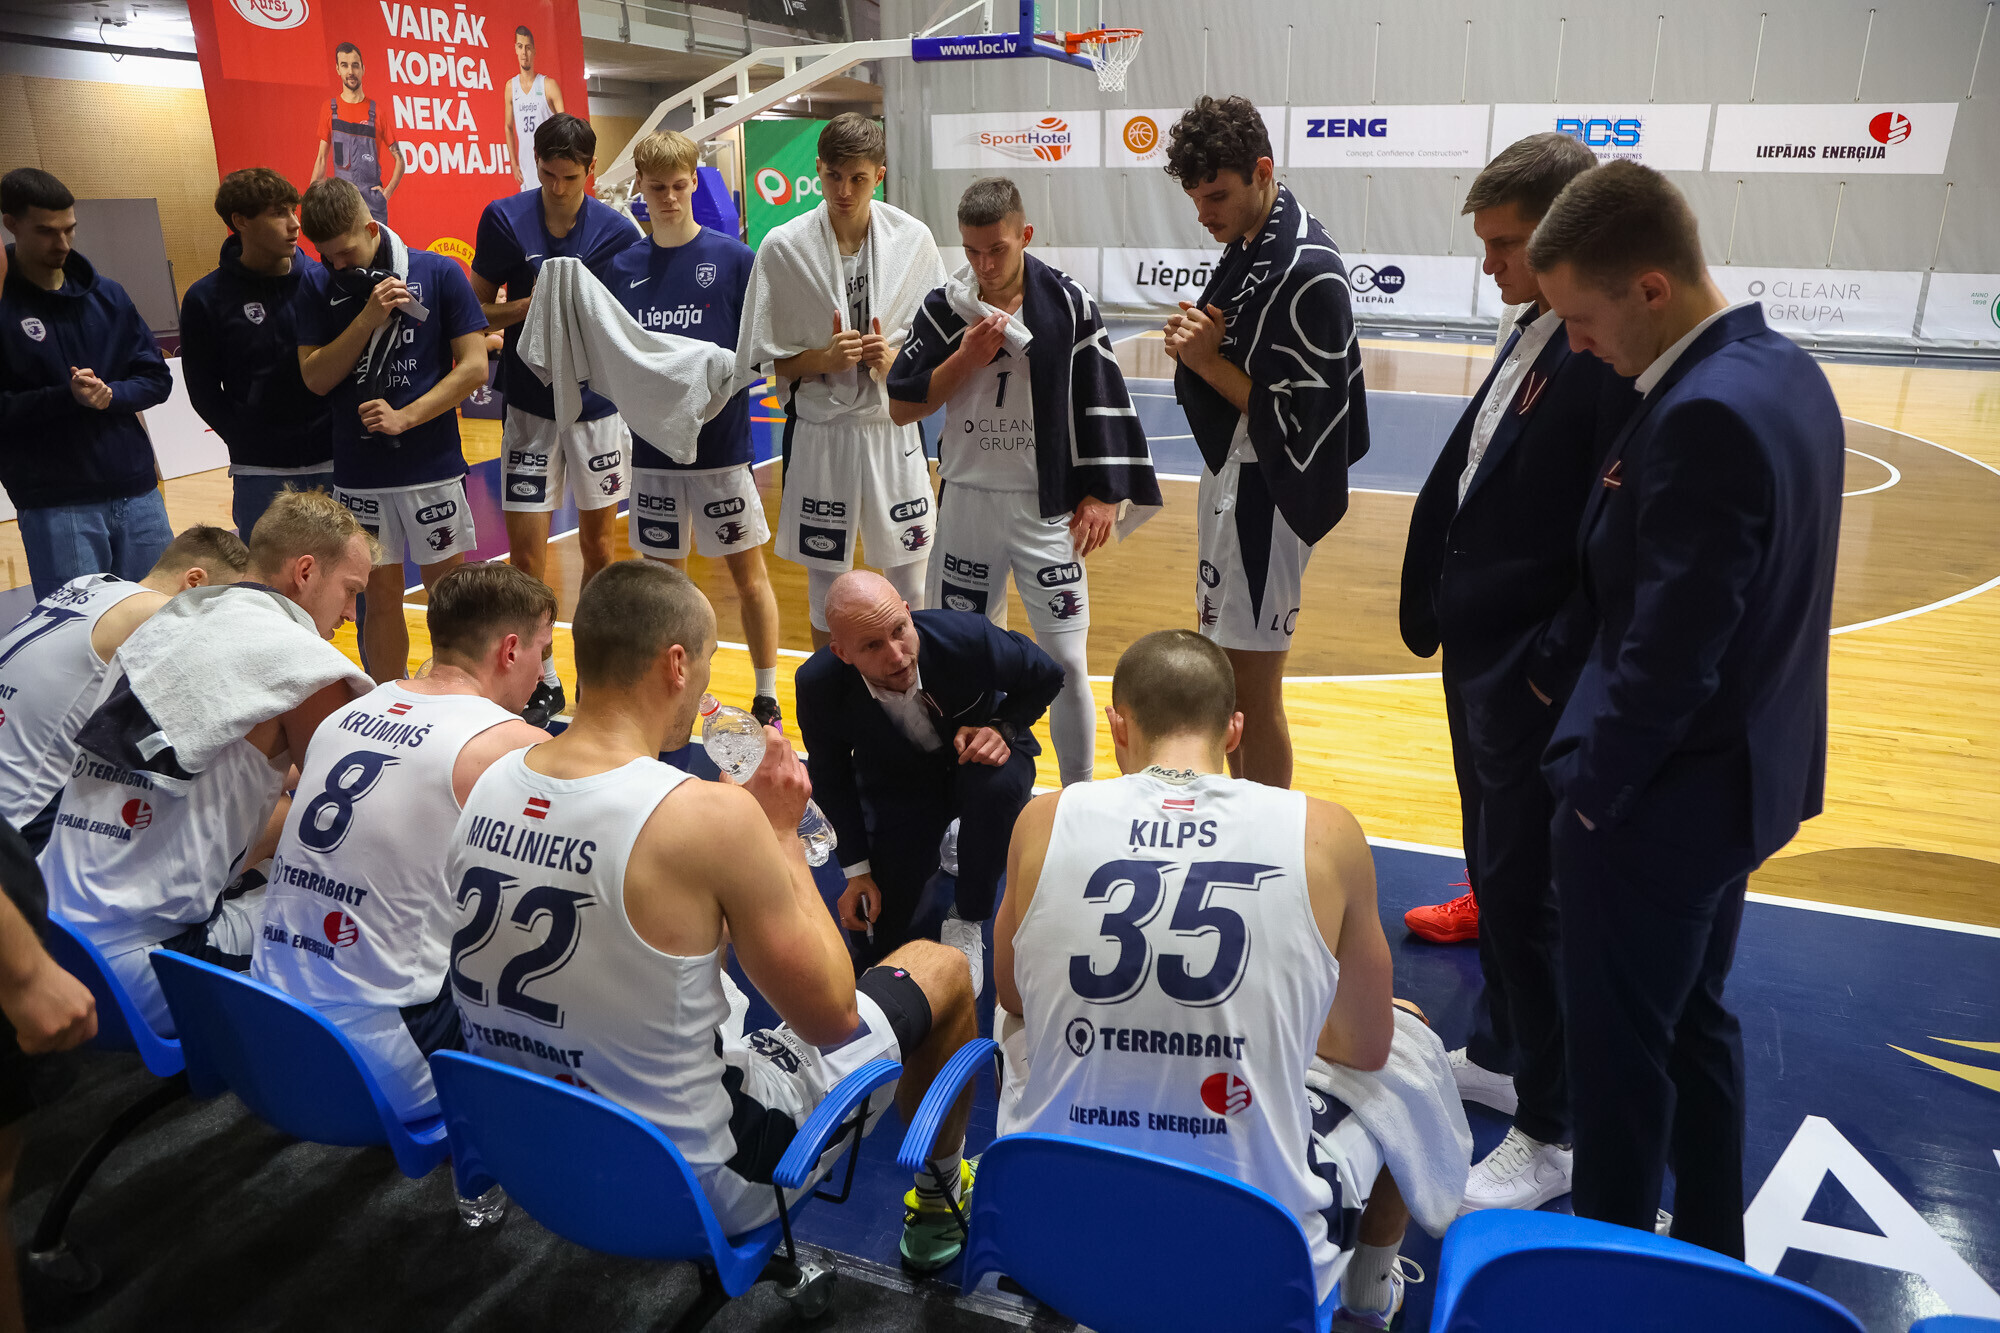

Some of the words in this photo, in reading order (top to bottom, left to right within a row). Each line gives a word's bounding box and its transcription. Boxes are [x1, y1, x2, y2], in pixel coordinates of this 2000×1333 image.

[379, 0, 489, 48] VAIRĀK
[939, 39, 1017, 56] www.loc.lv
[387, 46, 494, 91] KOPĪGA
[392, 91, 478, 132] NEKĀ
[523, 116, 536, 133] 35
[980, 132, 1071, 147] SportHotel
[1306, 119, 1388, 138] ZENG
[1556, 119, 1642, 147] BCS
[398, 134, 512, 175] DOMĀJI!
[1756, 143, 1817, 159] LIEPĀJAS
[1822, 145, 1886, 162] ENERĢIJA
[1379, 275, 1402, 285] LSEZ
[1772, 280, 1861, 300] CLEANR
[1356, 295, 1395, 304] LIEPĀJA
[1768, 304, 1844, 323] GRUPA
[638, 303, 703, 330] Liepāja
[994, 370, 1013, 409] 1
[979, 437, 1037, 451] GRUPA
[509, 450, 548, 468] BCS
[637, 492, 676, 512] BCS
[802, 496, 846, 517] BCS
[944, 553, 989, 580] BCS
[338, 710, 434, 750] KRŪMIŅŠ
[298, 750, 402, 854] 8
[466, 815, 597, 875] MIGLINIEKS
[1129, 819, 1218, 853] ĶILPS
[284, 864, 368, 907] TERRABALT
[450, 866, 598, 1029] 22
[1069, 859, 1286, 1008] 35
[472, 1022, 584, 1069] TERRABALT
[1099, 1027, 1245, 1061] TERRABALT
[1069, 1103, 1140, 1128] LIEPĀJAS
[1148, 1112, 1227, 1139] ENERĢIJA
